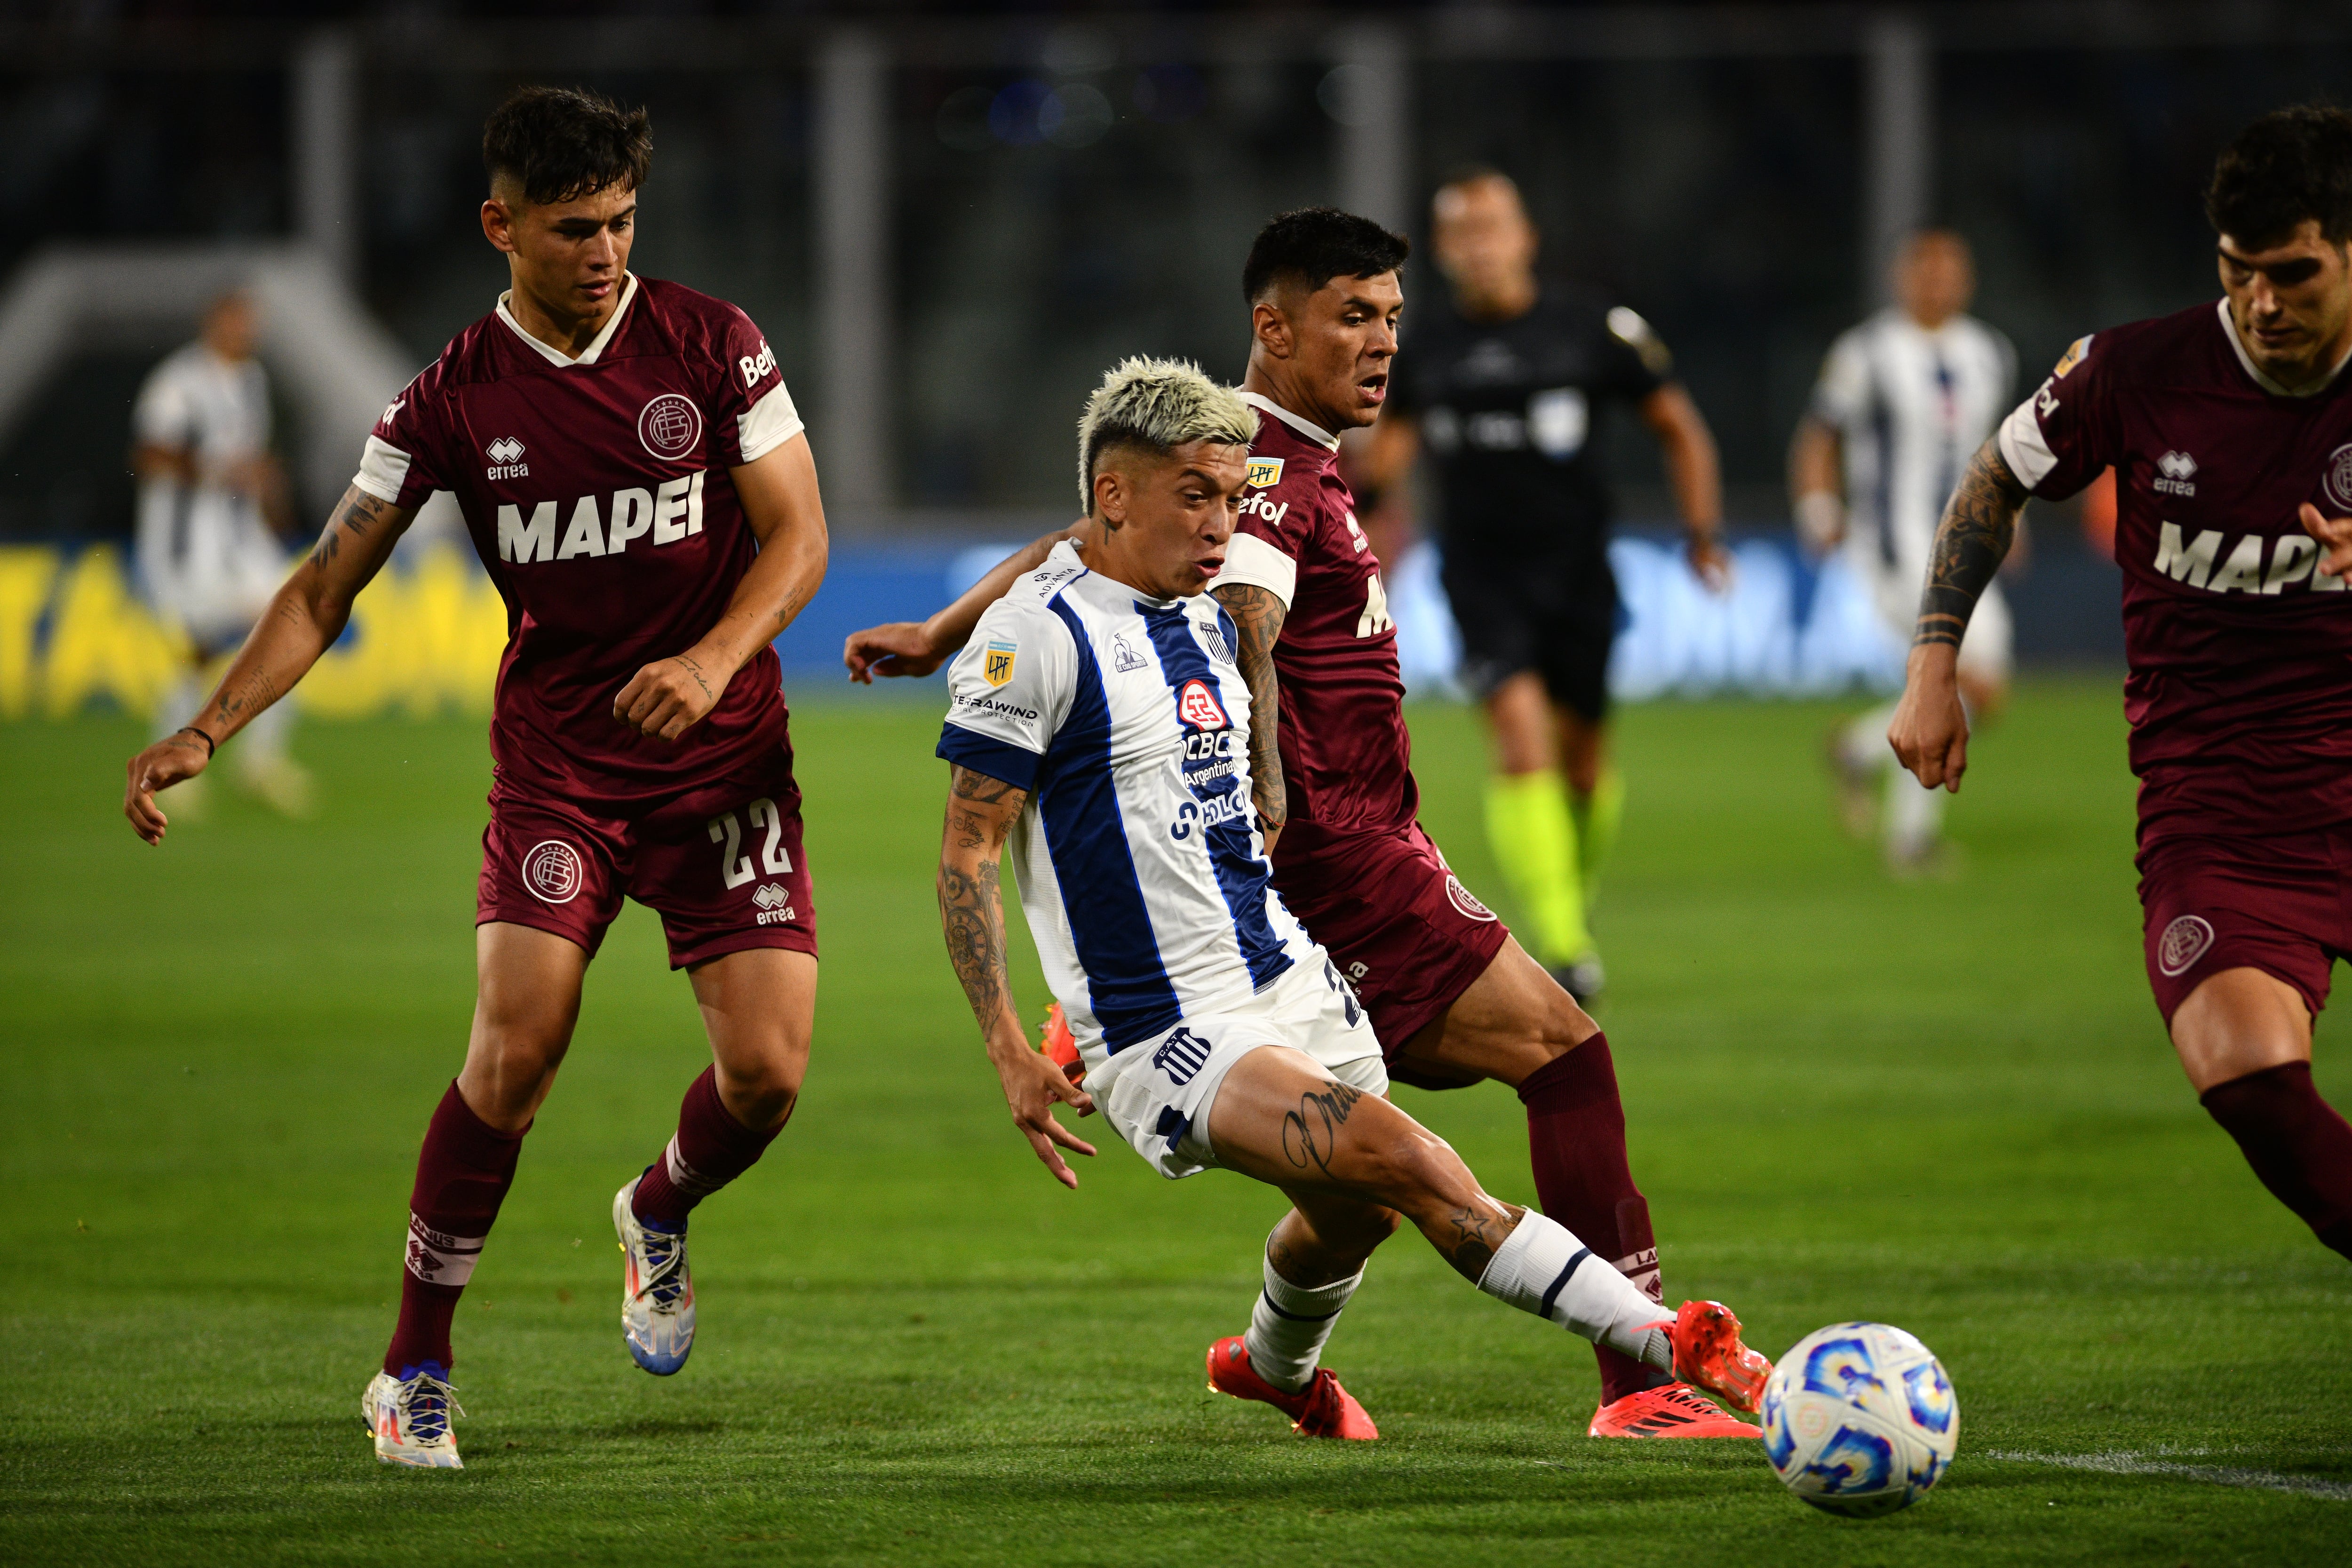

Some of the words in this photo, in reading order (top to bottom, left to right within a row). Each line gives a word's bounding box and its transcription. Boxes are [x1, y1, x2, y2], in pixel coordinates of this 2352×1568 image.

[739, 335, 776, 388] Befo
[497, 468, 707, 564] MAPEI
[1238, 492, 1289, 526] efol
[1039, 568, 1077, 598] ADVANTA
[954, 694, 1038, 719] TERRAWIND
[1184, 759, 1234, 789] Argentina
[707, 797, 794, 891] 22
